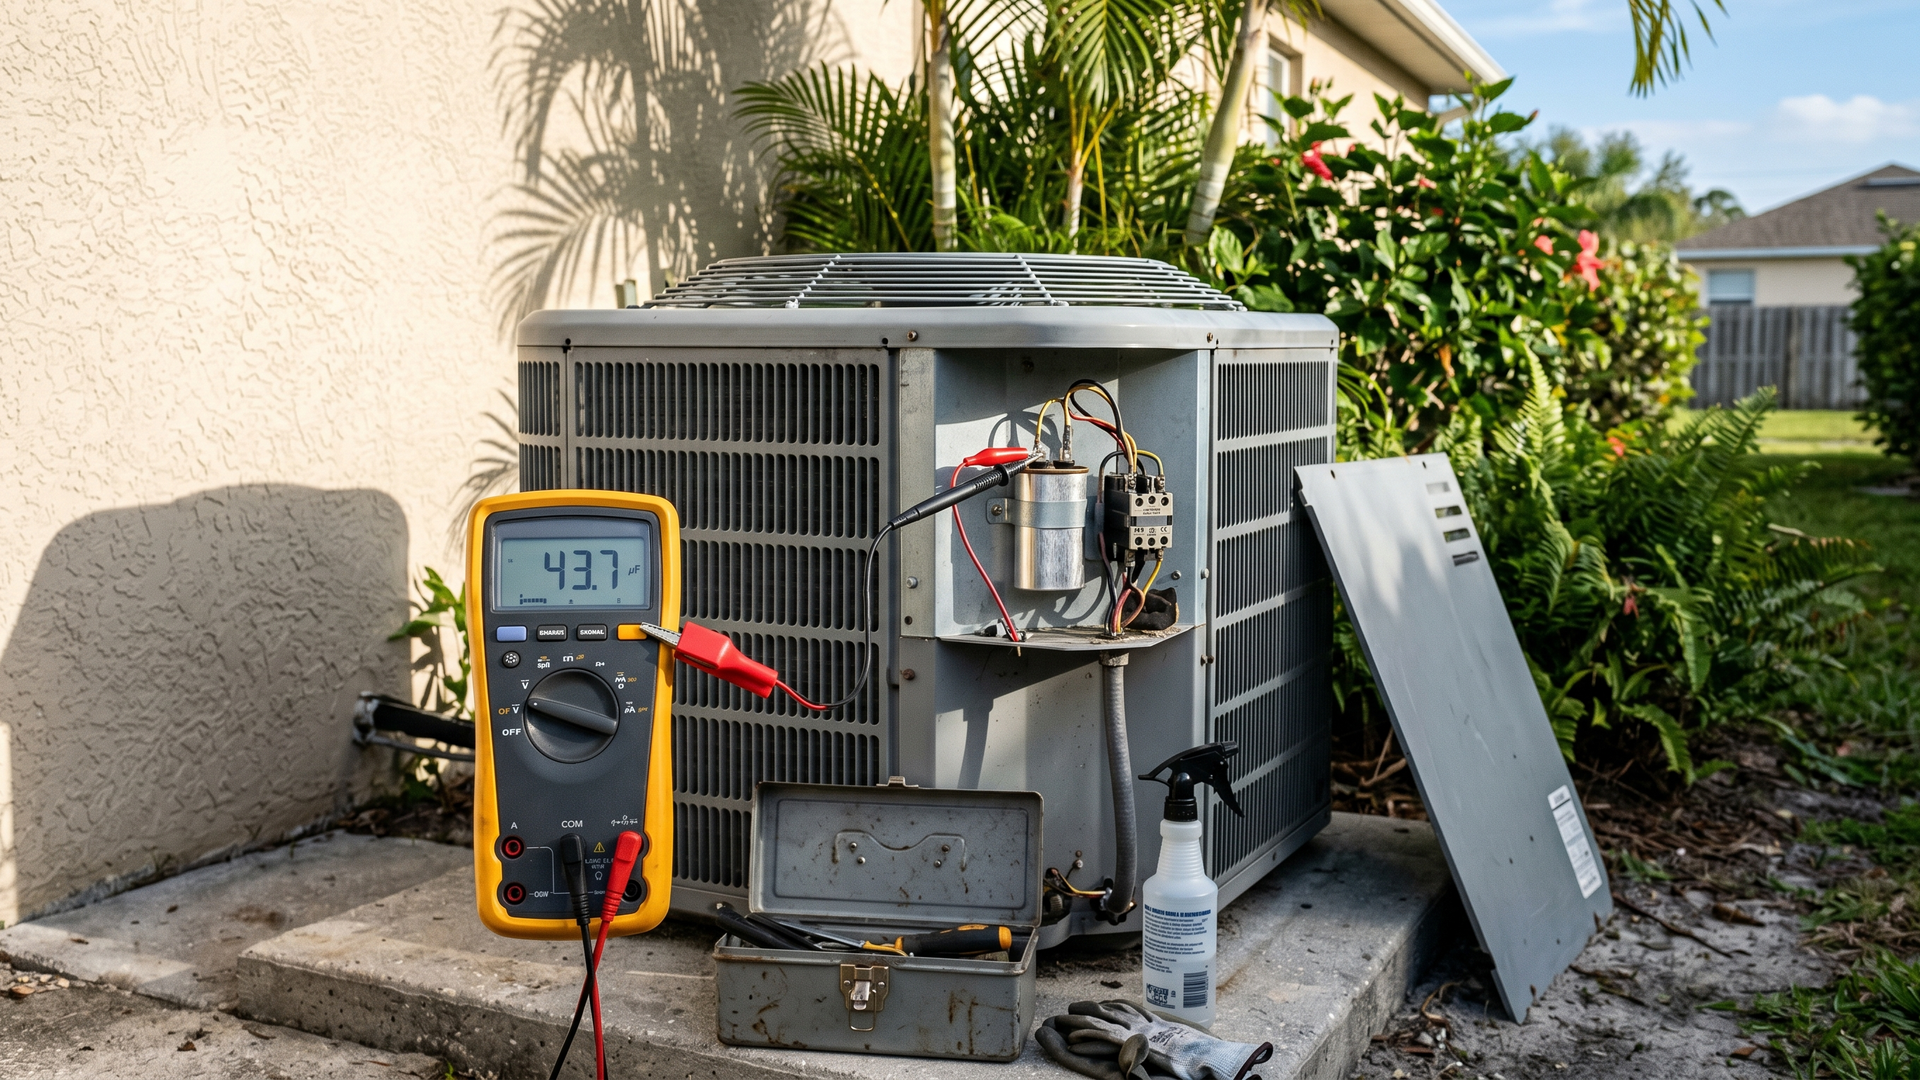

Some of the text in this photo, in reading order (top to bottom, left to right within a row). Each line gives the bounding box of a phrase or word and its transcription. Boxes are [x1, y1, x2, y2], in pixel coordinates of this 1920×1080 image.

[544, 550, 619, 590] 43.7
[502, 728, 522, 736] OFF
[510, 822, 518, 830] A
[561, 820, 583, 829] COM
